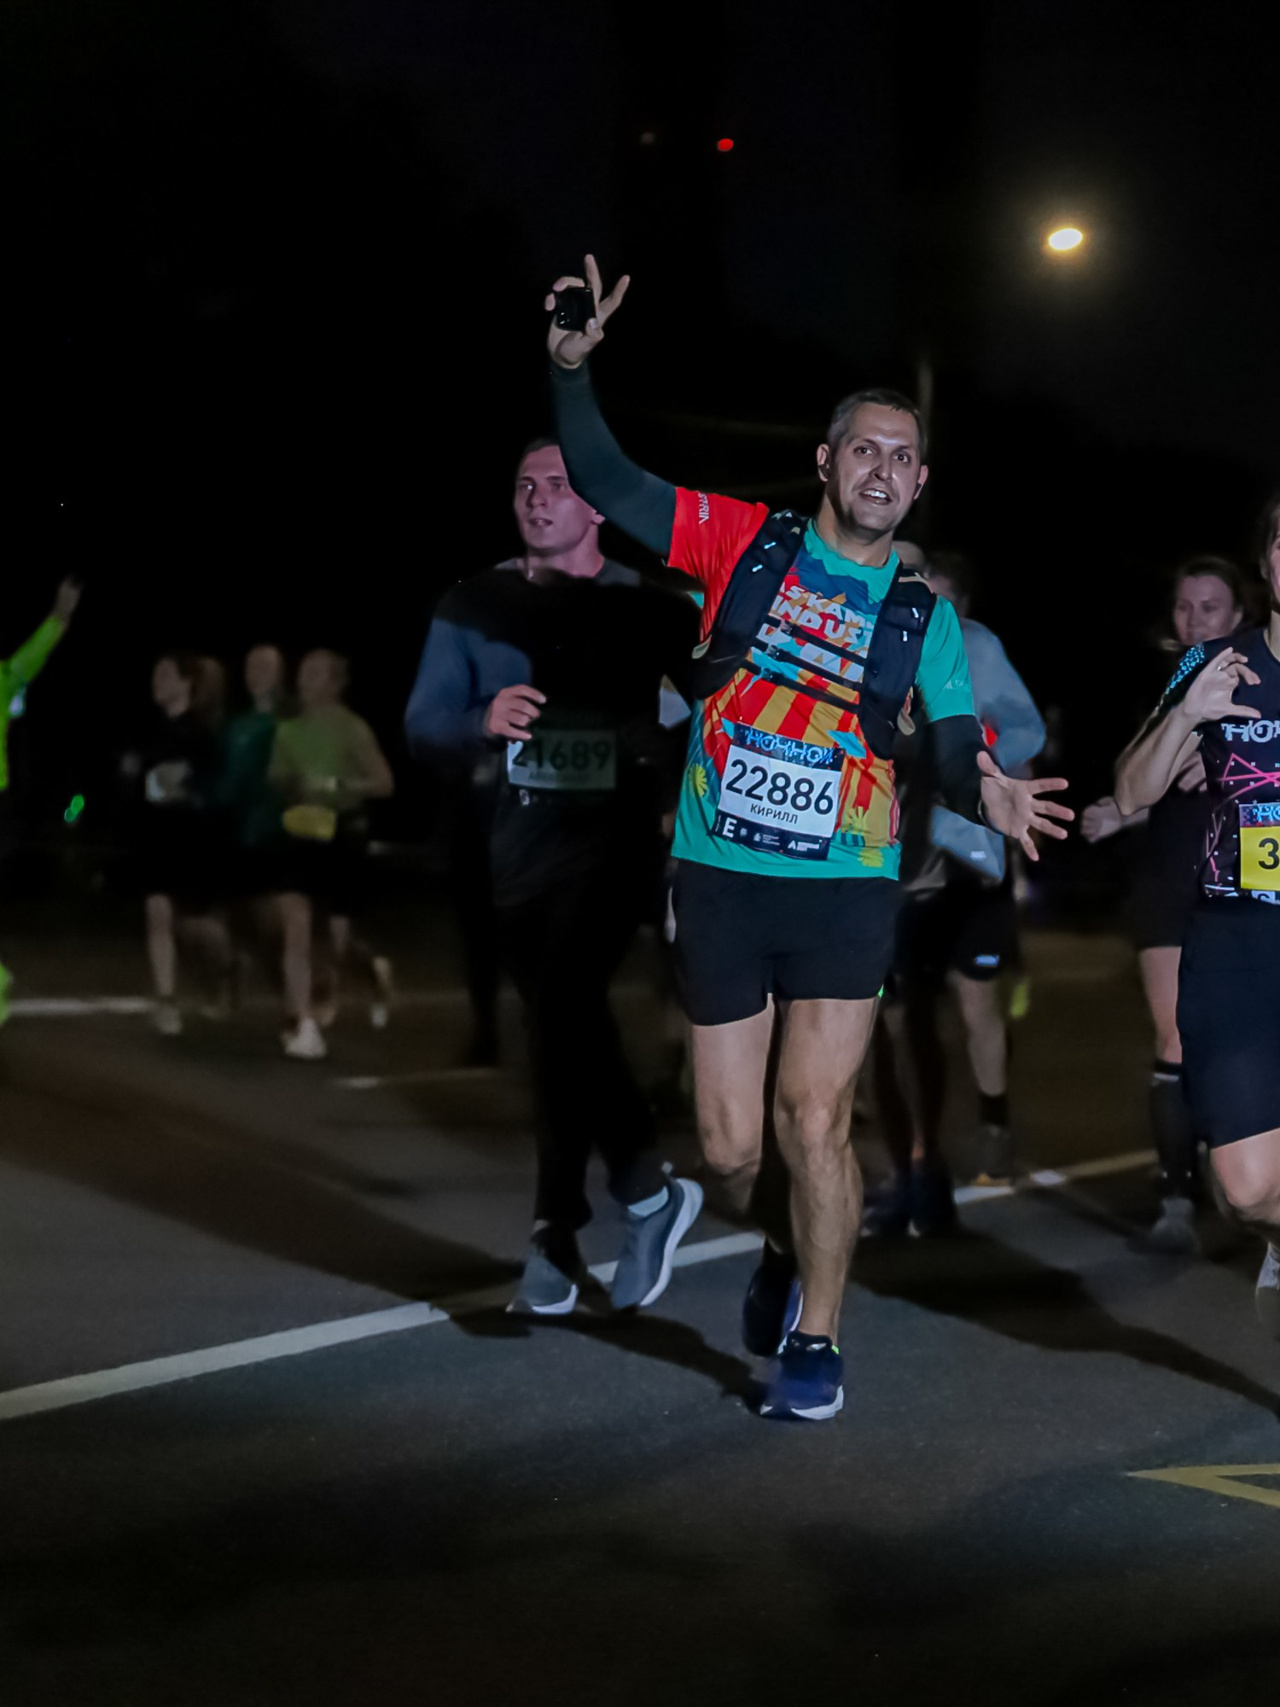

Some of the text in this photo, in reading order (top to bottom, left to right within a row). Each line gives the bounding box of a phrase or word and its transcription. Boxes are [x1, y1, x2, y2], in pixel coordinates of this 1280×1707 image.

[511, 739, 612, 771] 21689
[725, 758, 834, 816] 22886
[722, 816, 738, 839] E
[750, 803, 799, 825] КИРИЛЛ
